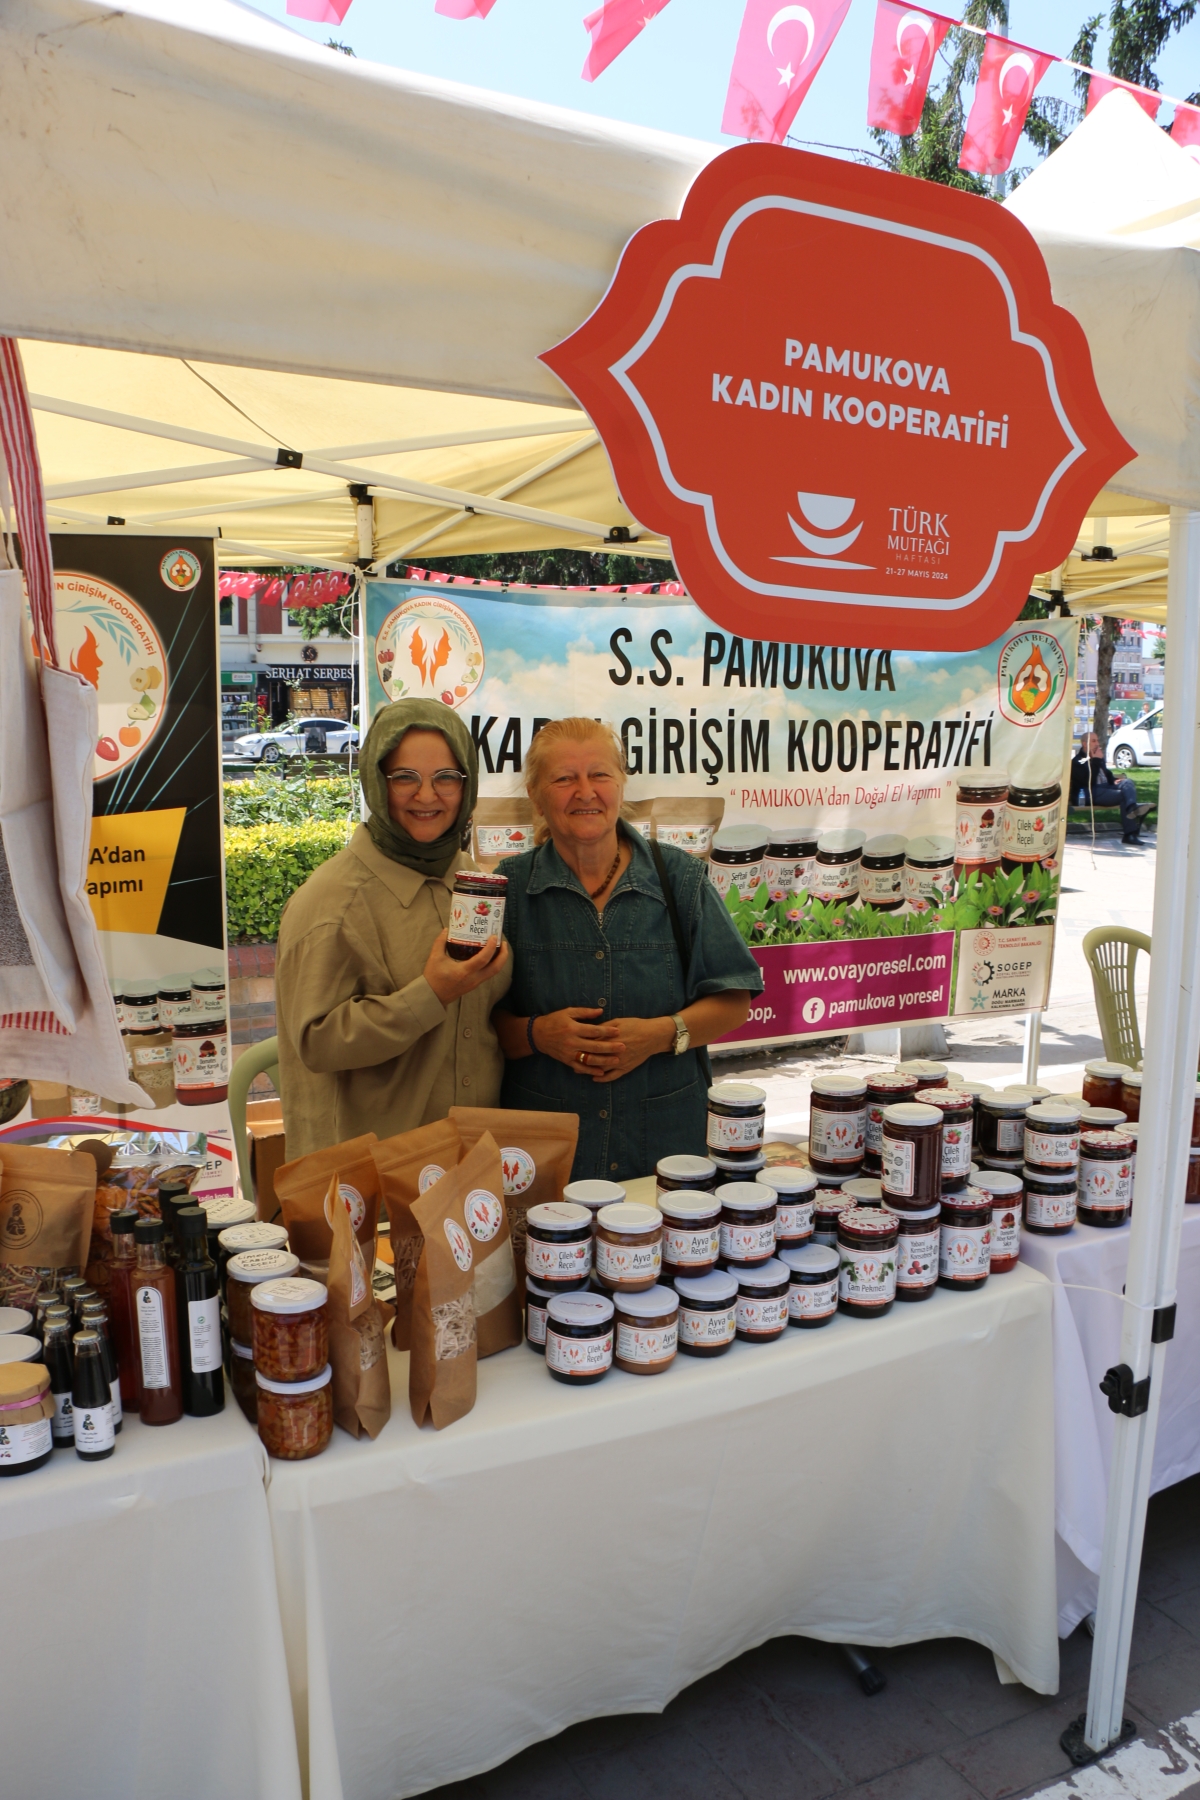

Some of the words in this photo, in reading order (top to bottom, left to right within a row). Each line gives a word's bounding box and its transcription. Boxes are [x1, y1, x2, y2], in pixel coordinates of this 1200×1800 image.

[785, 338, 951, 395] PAMUKOVA
[711, 373, 813, 418] KADIN
[822, 392, 1009, 449] KOOPERATİFİ
[888, 506, 950, 538] TÜRK
[887, 535, 950, 555] MUTFAĞI
[895, 553, 940, 565] HAFTASI
[885, 567, 906, 576] 21-27
[907, 569, 930, 579] MAYIS
[931, 571, 949, 580] 2024
[67, 581, 107, 601] GİRİŞİM
[107, 597, 157, 656] KOOPERATİFİ
[387, 604, 414, 630] PAMUKOVA
[608, 627, 684, 686] S.S.
[702, 631, 896, 692] PAMUKOVA
[1001, 635, 1030, 678] PAMUKOVA
[265, 667, 312, 681] SERHAT
[620, 707, 770, 785] GİRİŞİM
[787, 710, 995, 773] KOOPERATİFİ
[741, 786, 850, 810] PAMUKOVA'dan
[854, 786, 888, 810] Doğal
[891, 783, 904, 803] El
[907, 783, 942, 806] Yapımı
[89, 846, 146, 865] A'dan
[84, 879, 143, 899] apımı
[473, 916, 488, 926] Çilek
[470, 924, 488, 935] Reçeli
[783, 953, 946, 986] www.ovayoresel.com
[997, 961, 1032, 972] SOGEP
[992, 987, 1026, 999] MARKA
[828, 994, 897, 1019] pamukova
[898, 985, 944, 1007] yoresel
[747, 1006, 776, 1023] oop.
[944, 1146, 960, 1157] Çilek
[692, 1236, 709, 1247] Ayva
[558, 1251, 574, 1261] Çilek
[691, 1246, 708, 1256] Reçeli
[558, 1261, 576, 1270] Reçeli
[633, 1253, 651, 1266] Ayva
[847, 1282, 860, 1292] Çam
[708, 1317, 726, 1328] Ayva
[761, 1313, 778, 1324] Reçeli
[662, 1331, 676, 1344] Ayva
[707, 1326, 726, 1337] Reçeli
[587, 1345, 601, 1355] Çilek
[586, 1353, 603, 1364] Reçeli
